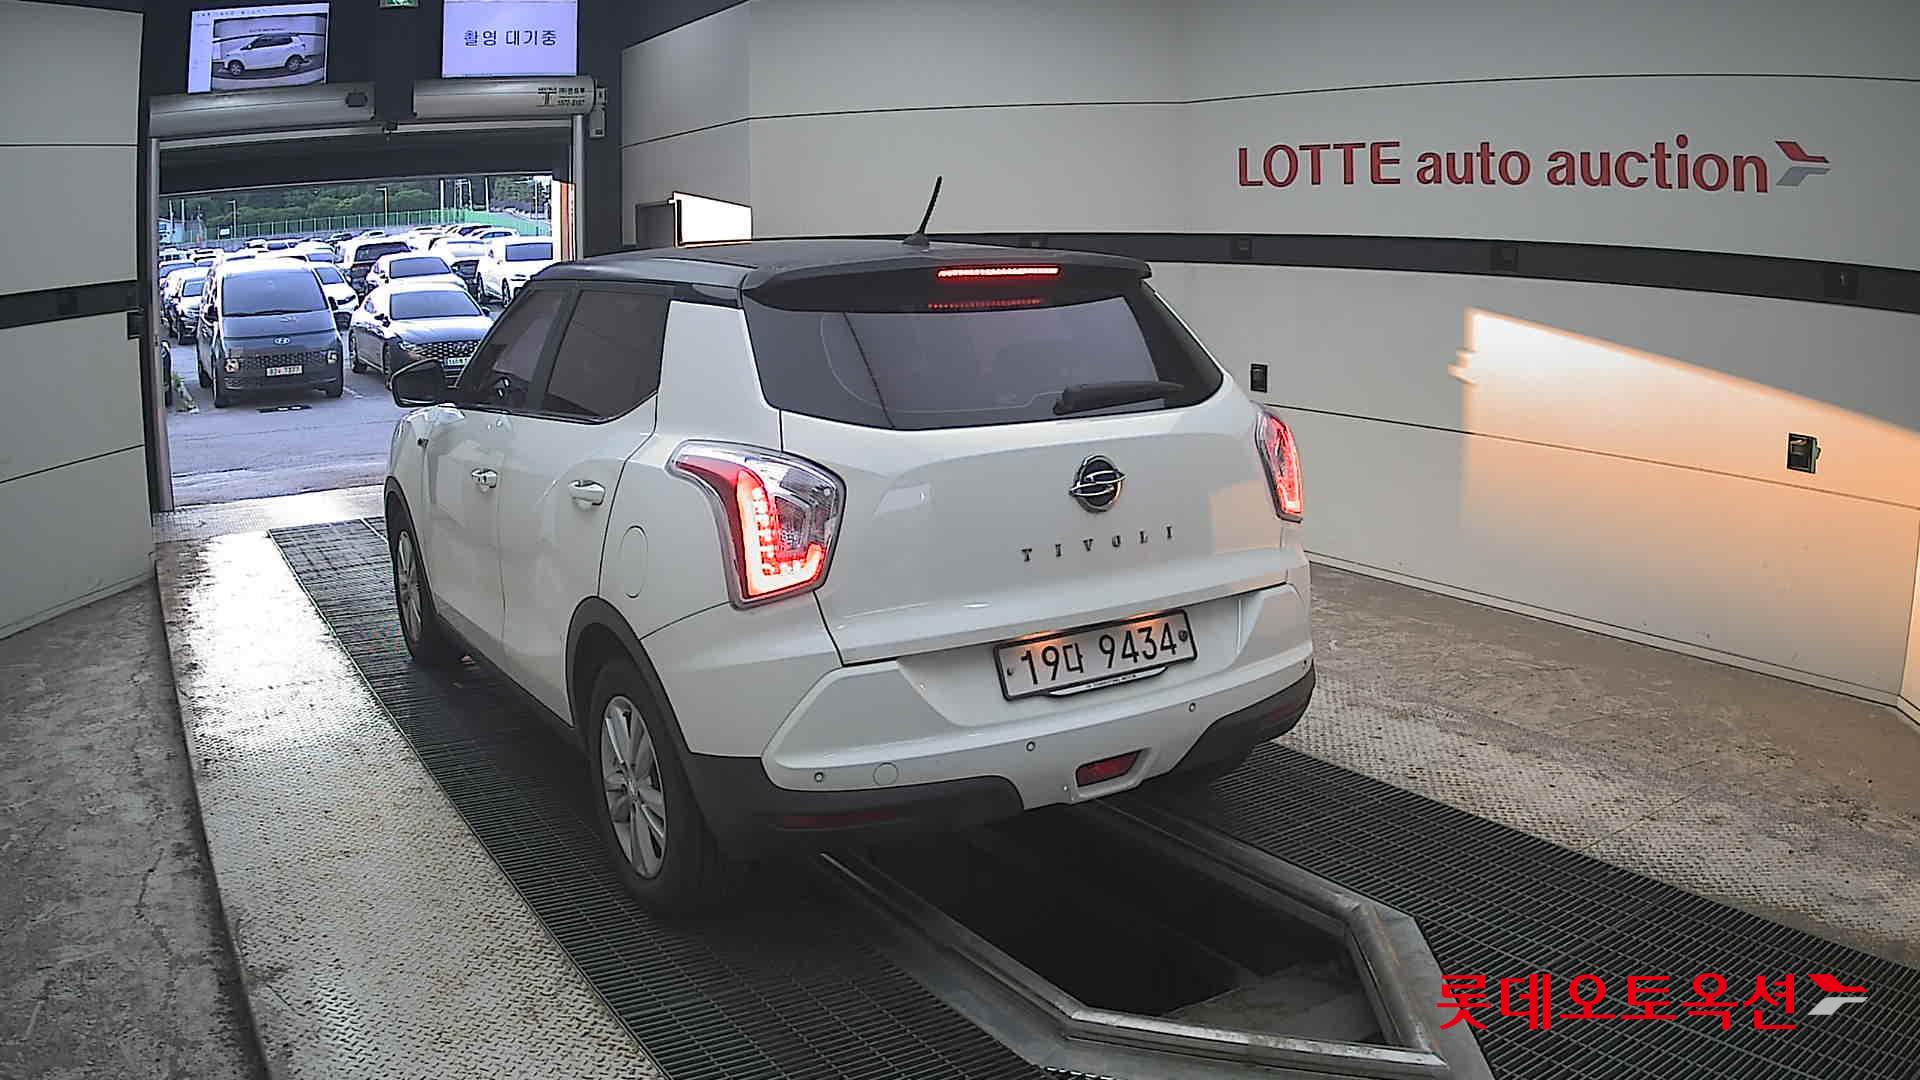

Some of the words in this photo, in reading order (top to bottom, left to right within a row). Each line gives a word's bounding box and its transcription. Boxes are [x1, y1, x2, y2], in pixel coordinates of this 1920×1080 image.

[505, 30, 557, 46] 대기중
[1238, 141, 1400, 188] LOTTE
[1416, 142, 1531, 186] auto
[1547, 134, 1768, 193] auction
[1020, 525, 1173, 562] TIVOLI
[1021, 642, 1084, 685] 19다
[1099, 622, 1177, 669] 9434
